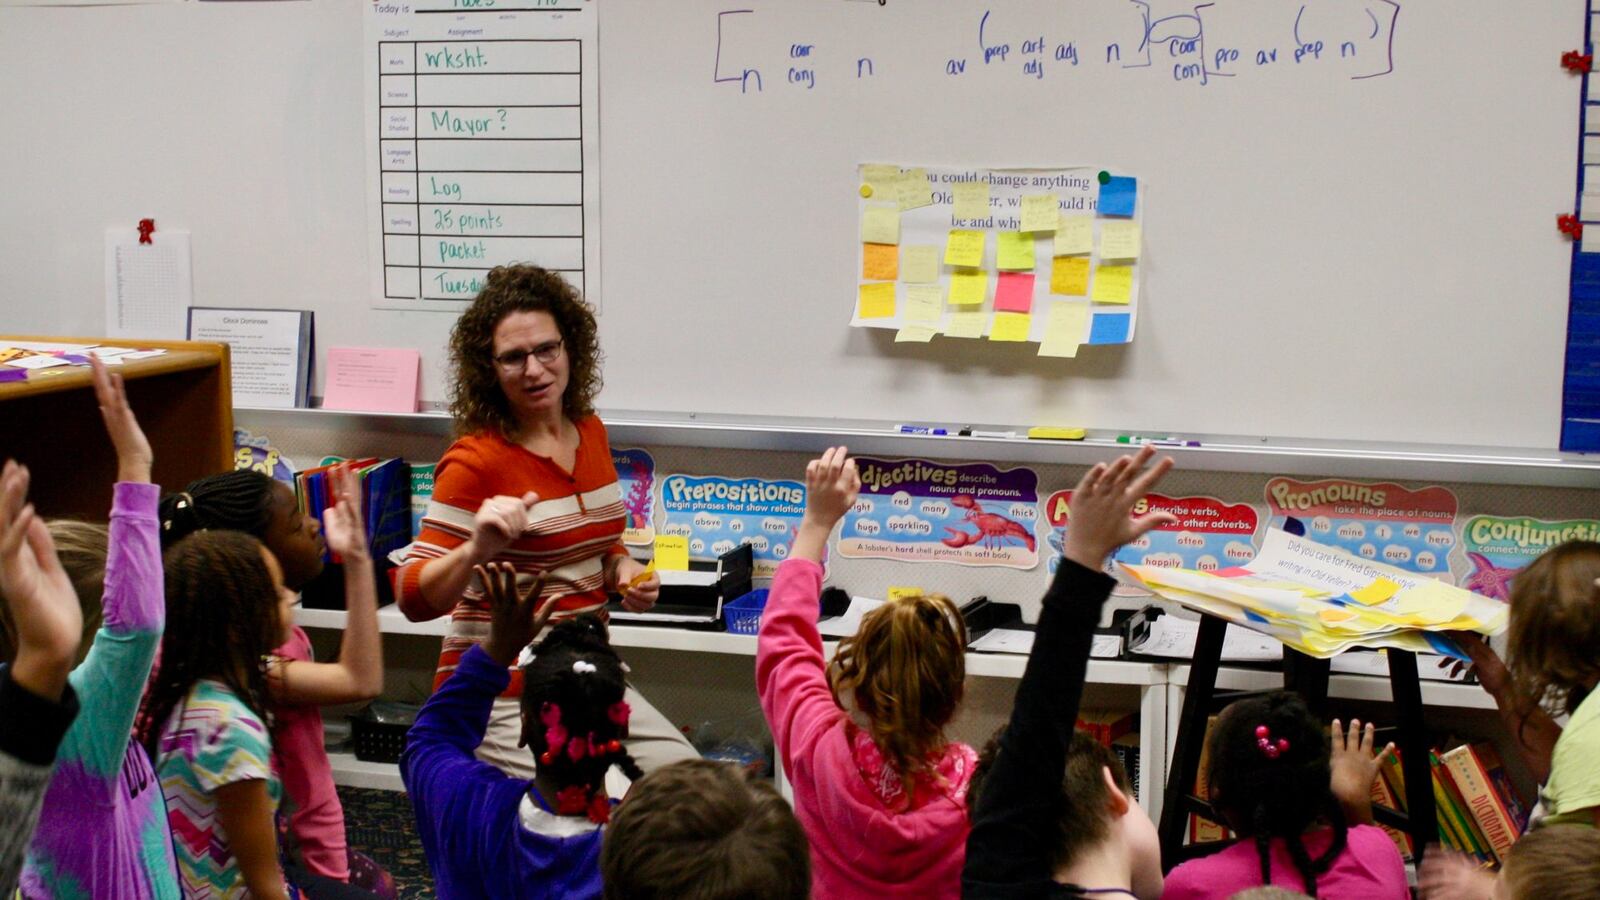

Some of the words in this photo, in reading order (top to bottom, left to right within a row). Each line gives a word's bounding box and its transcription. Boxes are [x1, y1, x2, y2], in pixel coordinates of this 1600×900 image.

[374, 4, 400, 14] Today
[858, 57, 872, 78] n
[1107, 43, 1120, 62] n
[1215, 48, 1238, 70] pro
[1341, 41, 1356, 56] n
[942, 172, 976, 184] could
[982, 172, 1028, 188] change
[1032, 174, 1090, 190] anything
[431, 176, 462, 200] Log
[1059, 198, 1084, 210] uld
[1089, 198, 1096, 210] it
[434, 209, 454, 230] 25
[460, 210, 503, 233] points
[952, 215, 966, 227] be
[970, 216, 992, 228] and
[440, 241, 486, 263] packet
[434, 272, 484, 294] Tuesda
[853, 462, 956, 492] djectives
[960, 473, 997, 484] describe
[416, 482, 434, 492] plac
[670, 478, 802, 503] Prepositions
[958, 486, 976, 494] and
[978, 487, 1021, 497] pronouns.
[1272, 483, 1386, 510] Pronouns
[666, 500, 690, 510] begin
[692, 502, 725, 512] phrases
[727, 503, 743, 512] that
[746, 503, 768, 512] show
[853, 502, 870, 512] ight
[894, 498, 909, 506] red
[922, 506, 947, 514] many
[1012, 508, 1034, 516] thick
[1150, 505, 1188, 514] describe
[1192, 506, 1220, 517] verbs,
[1335, 506, 1356, 514] take
[1360, 506, 1374, 515] the
[1377, 508, 1404, 518] place
[1408, 509, 1420, 517] of
[696, 518, 720, 526] above
[764, 522, 786, 530] from
[857, 524, 878, 533] huge
[889, 522, 930, 532] sparkling
[1184, 518, 1208, 528] other
[1212, 520, 1252, 530] adverbs.
[1314, 521, 1328, 530] his
[1340, 528, 1363, 536] mine
[1472, 519, 1600, 547] Conjuncti
[1428, 535, 1450, 544] hers
[776, 547, 785, 555] to
[865, 544, 894, 552] lobster's
[934, 548, 962, 556] protects
[1228, 549, 1252, 558] there
[1362, 548, 1373, 556] us
[1386, 550, 1408, 558] ours
[1478, 545, 1518, 554] connect
[1288, 540, 1300, 551] Did
[1301, 546, 1314, 558] you
[1315, 551, 1332, 562] care
[1332, 555, 1345, 566] for
[1346, 558, 1362, 573] Fred
[1146, 558, 1181, 568] happily
[1198, 561, 1216, 570] fast
[1278, 560, 1304, 574] writing
[1304, 566, 1311, 576] in
[1472, 794, 1510, 852] DICTIONARY
